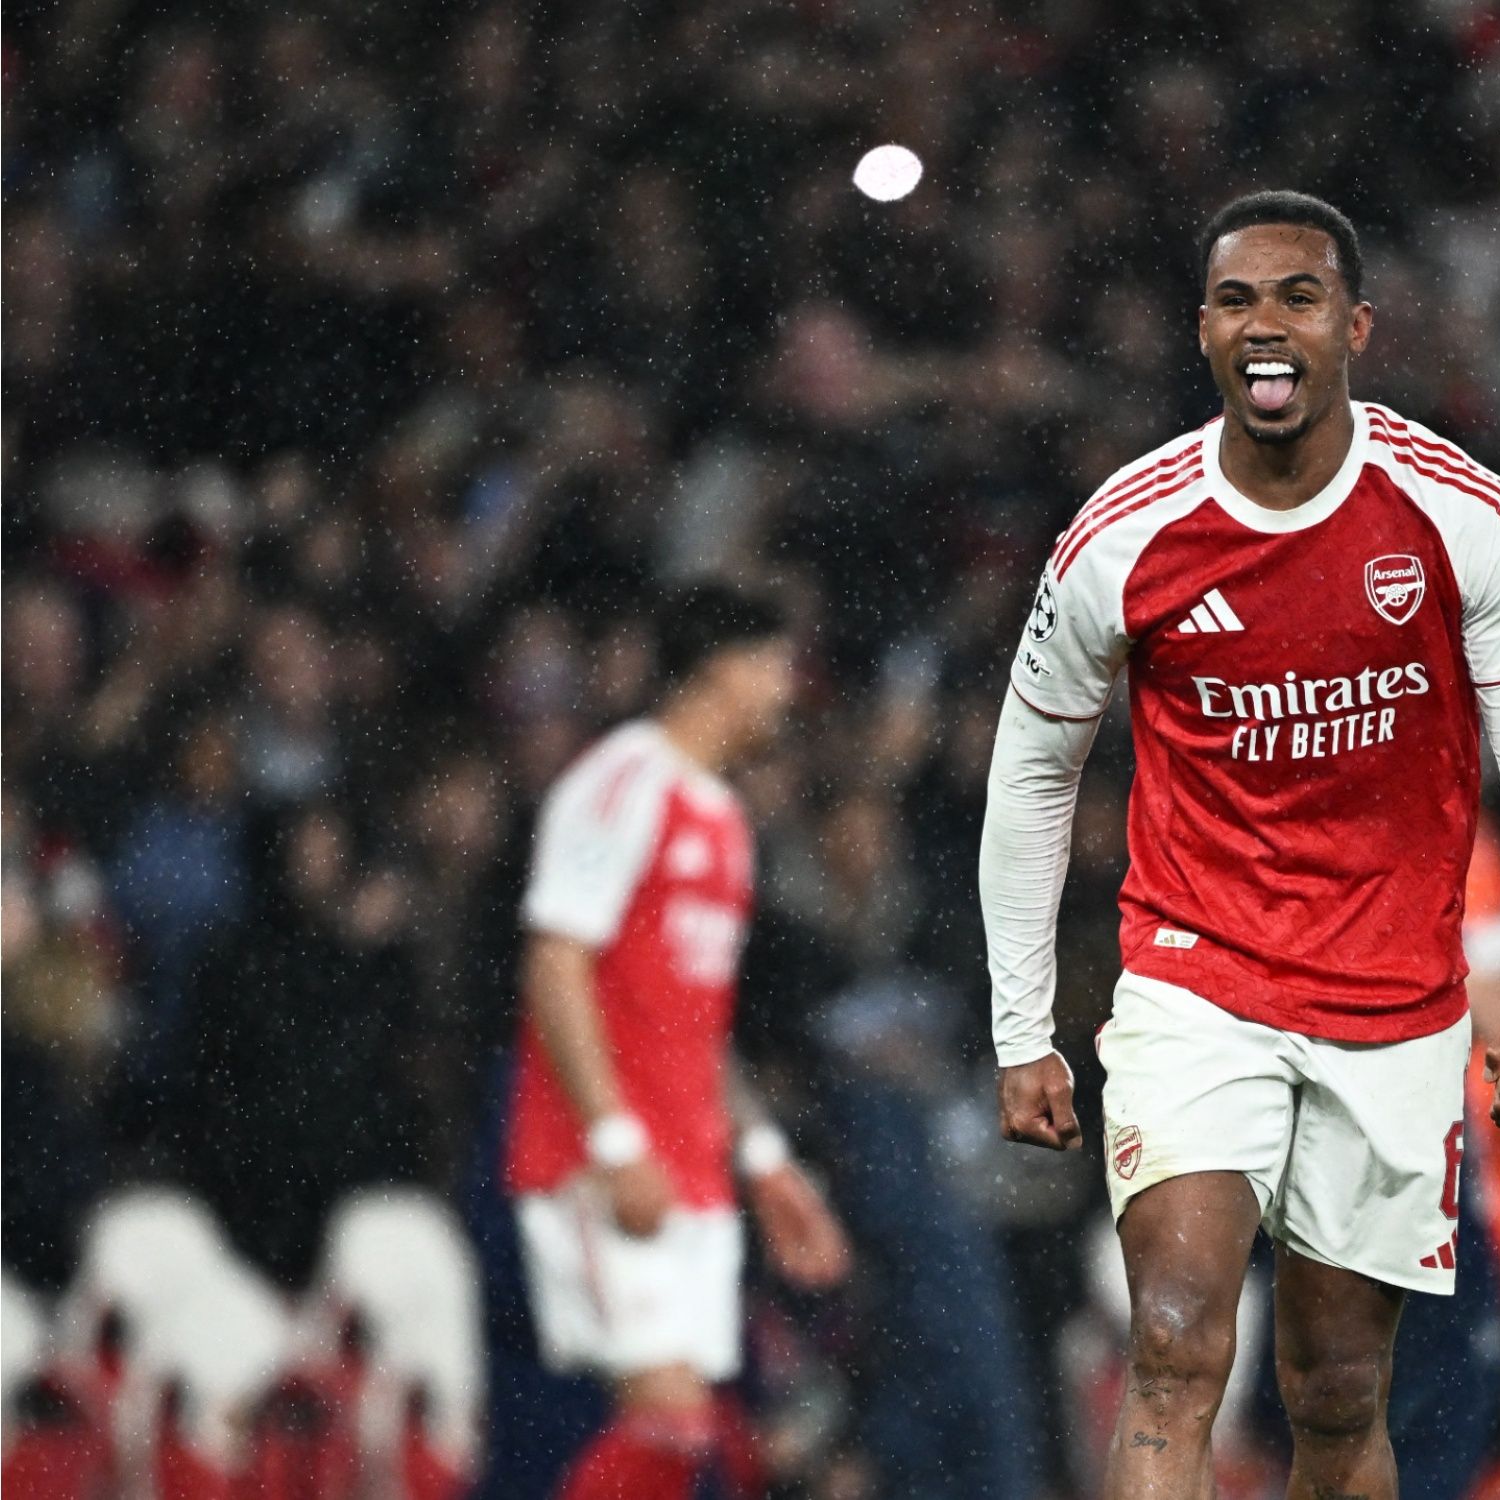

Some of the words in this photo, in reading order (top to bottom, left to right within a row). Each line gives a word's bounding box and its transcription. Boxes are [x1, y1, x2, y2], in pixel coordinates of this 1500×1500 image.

[1373, 566, 1415, 580] Arsenal
[1191, 662, 1430, 721] Emirates
[1231, 725, 1280, 762] FLY
[1291, 708, 1396, 760] BETTER
